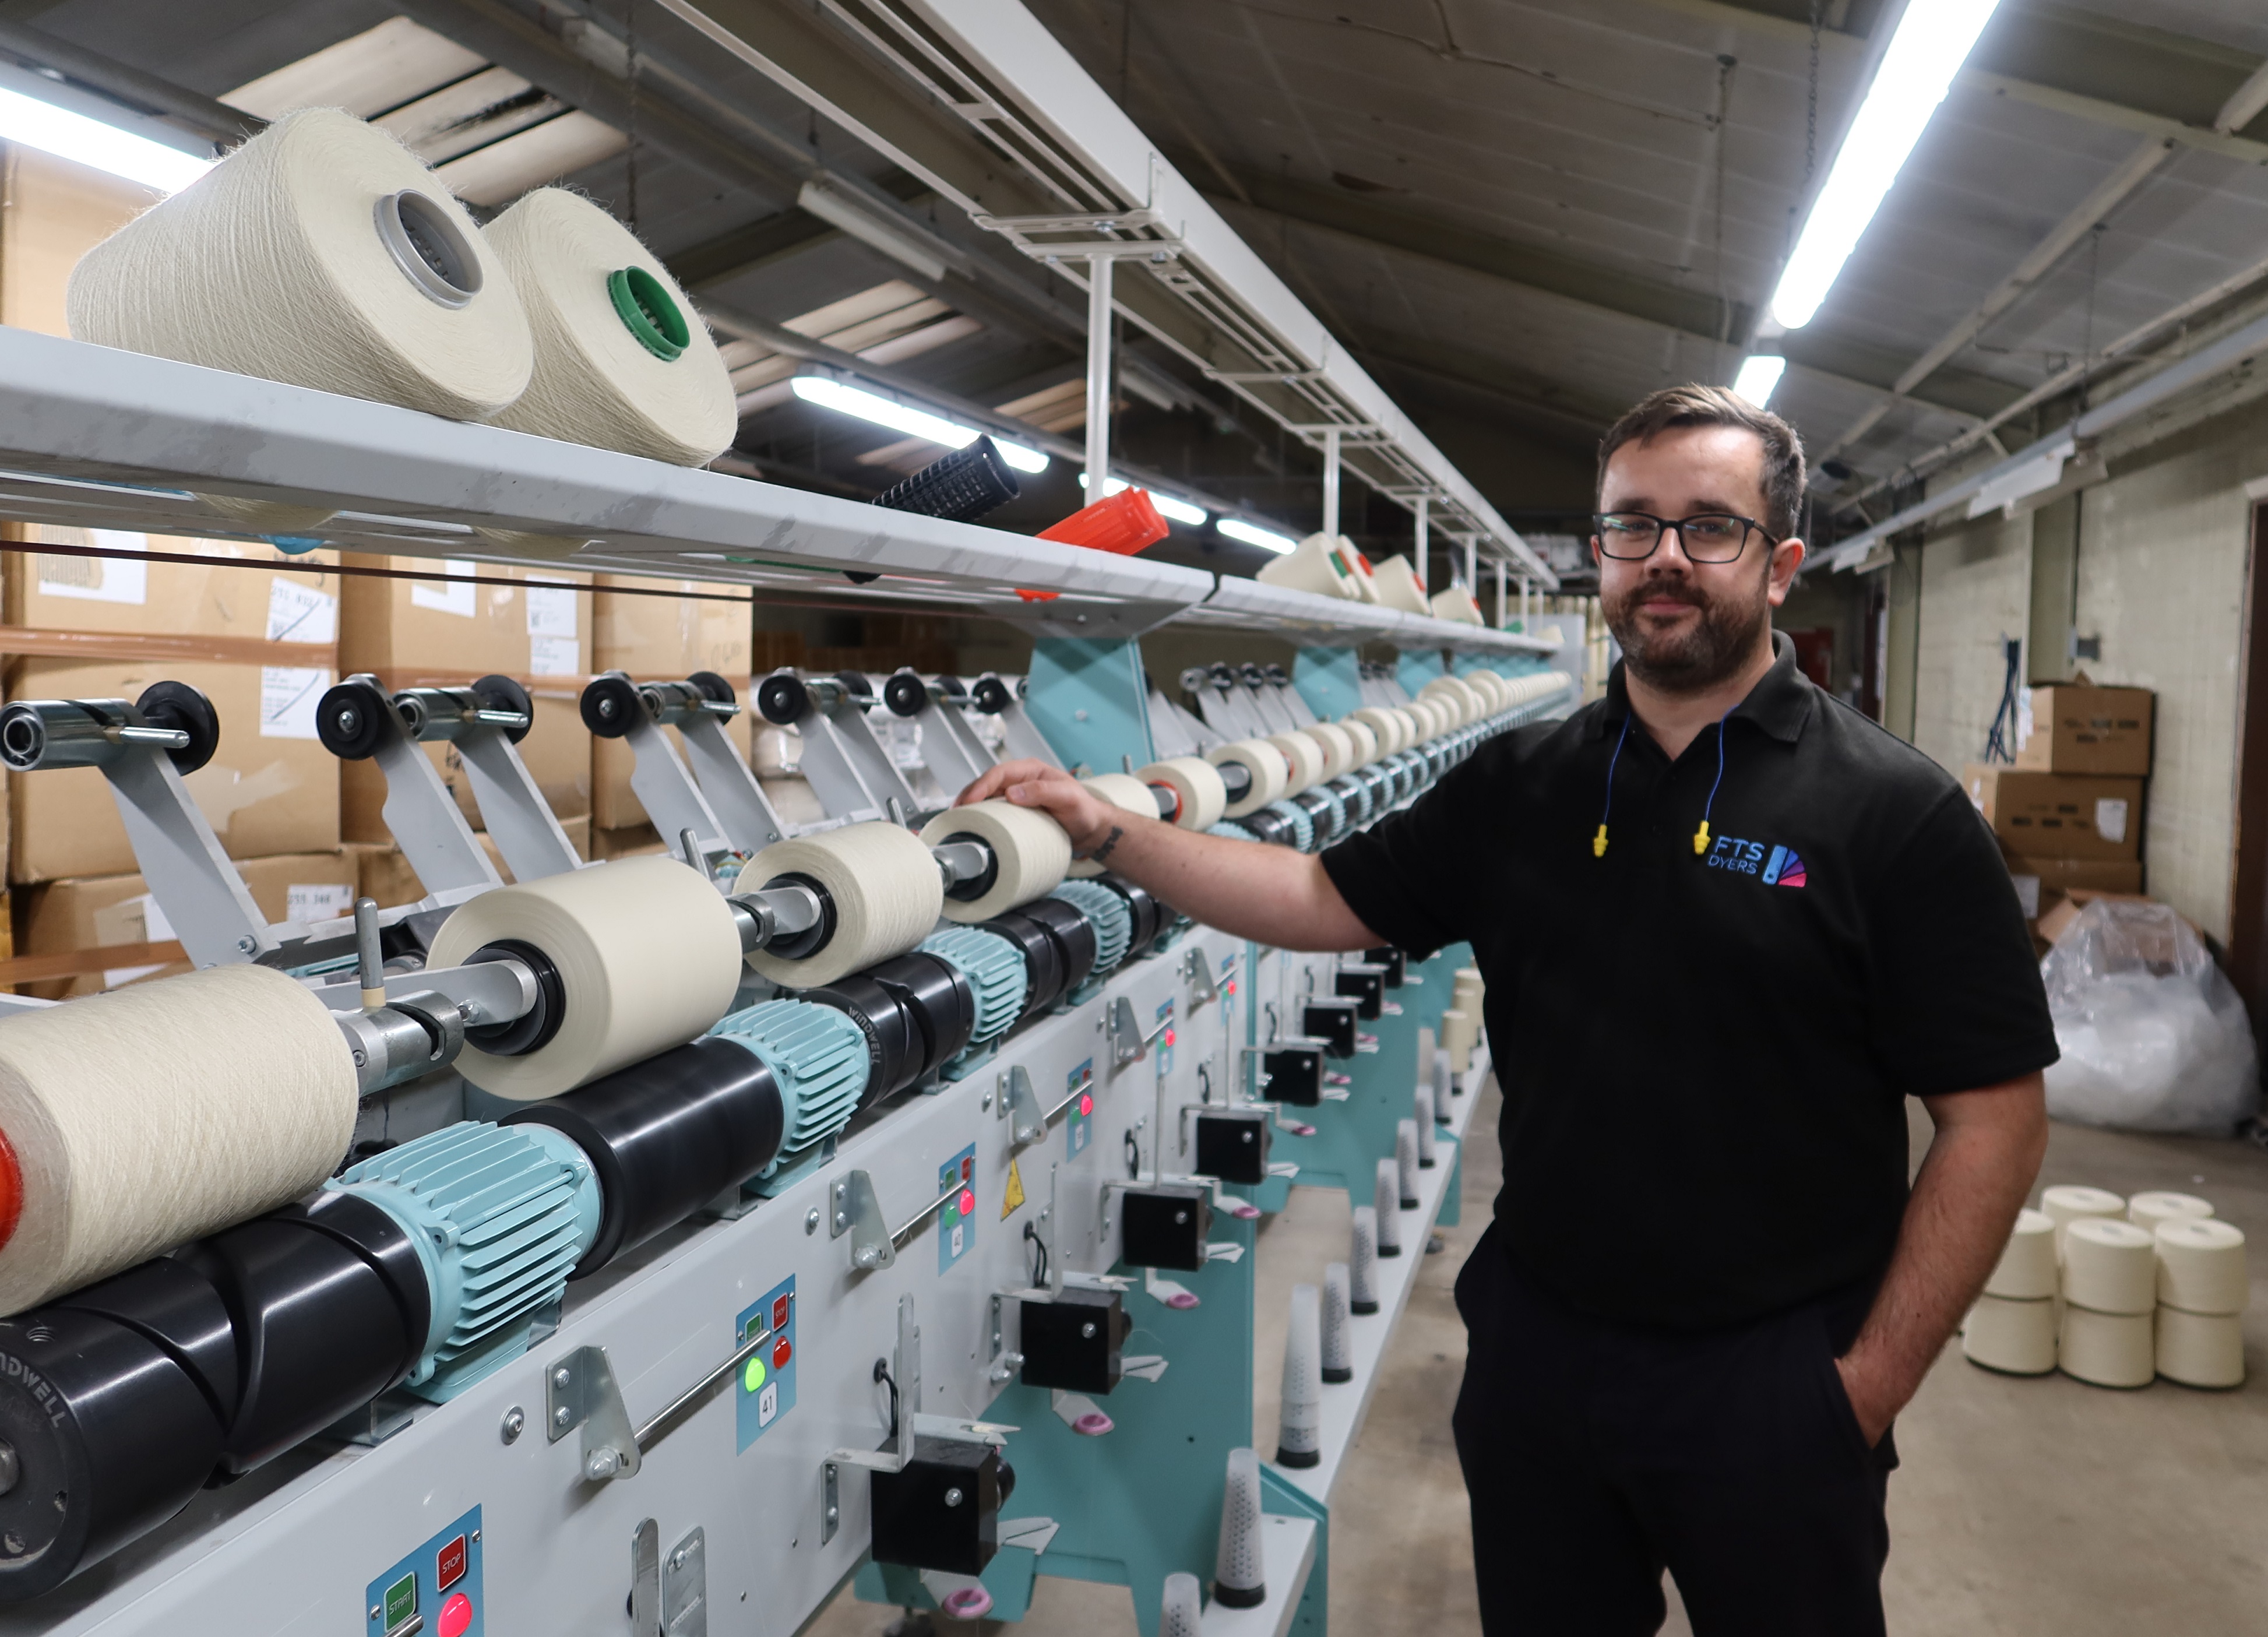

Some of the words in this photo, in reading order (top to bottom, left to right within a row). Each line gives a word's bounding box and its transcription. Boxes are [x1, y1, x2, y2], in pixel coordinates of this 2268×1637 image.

[1715, 836, 1765, 861] FTS
[1709, 854, 1758, 874] DYERS
[762, 1395, 773, 1414] 41
[442, 1552, 462, 1575] STOP
[389, 1590, 412, 1617] START
